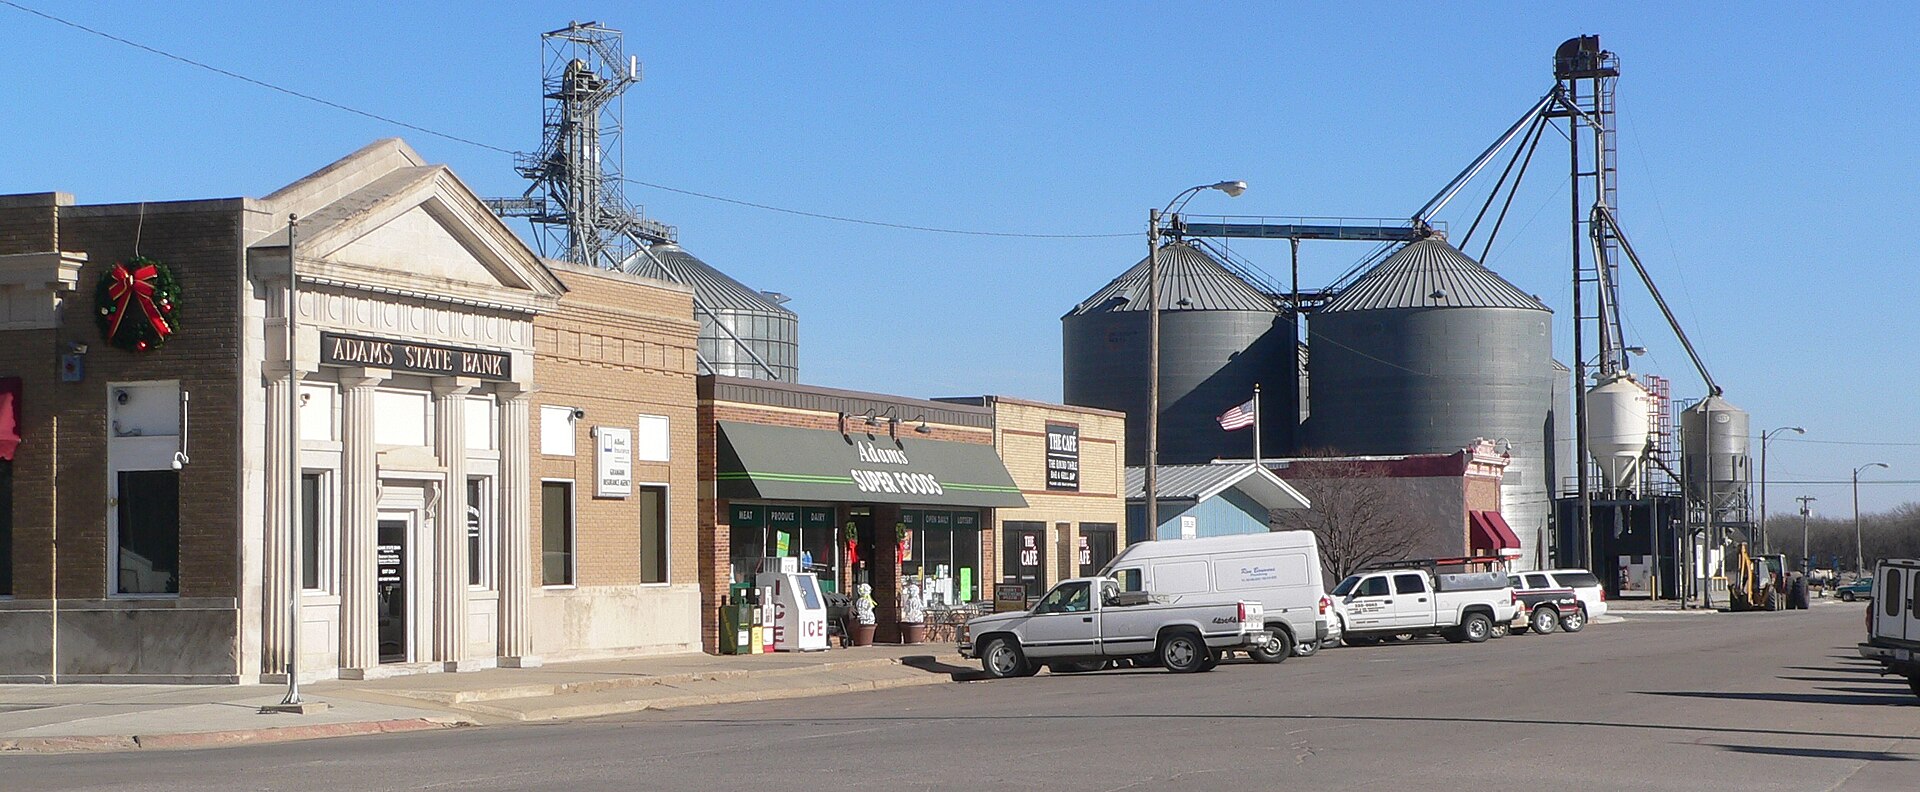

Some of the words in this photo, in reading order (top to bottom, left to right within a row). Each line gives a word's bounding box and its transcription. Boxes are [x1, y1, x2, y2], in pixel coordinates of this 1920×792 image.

[333, 338, 394, 365] ADAMS
[405, 346, 453, 371] STATE
[461, 352, 504, 376] BANK
[1048, 432, 1062, 451] THE
[1062, 430, 1077, 452] CAFÉ
[857, 440, 909, 465] Adams
[1048, 458, 1056, 469] THE
[850, 469, 900, 494] SUPER
[893, 471, 943, 495] FOODS
[739, 510, 753, 520] MEAT
[771, 511, 795, 521] PRODUCE
[811, 512, 826, 522] DAIRY
[925, 515, 937, 523] OPEN
[1024, 535, 1035, 547] THE
[1021, 546, 1038, 566] CAFÉ
[1079, 546, 1091, 565] AFÉ
[802, 620, 824, 638] ICE
